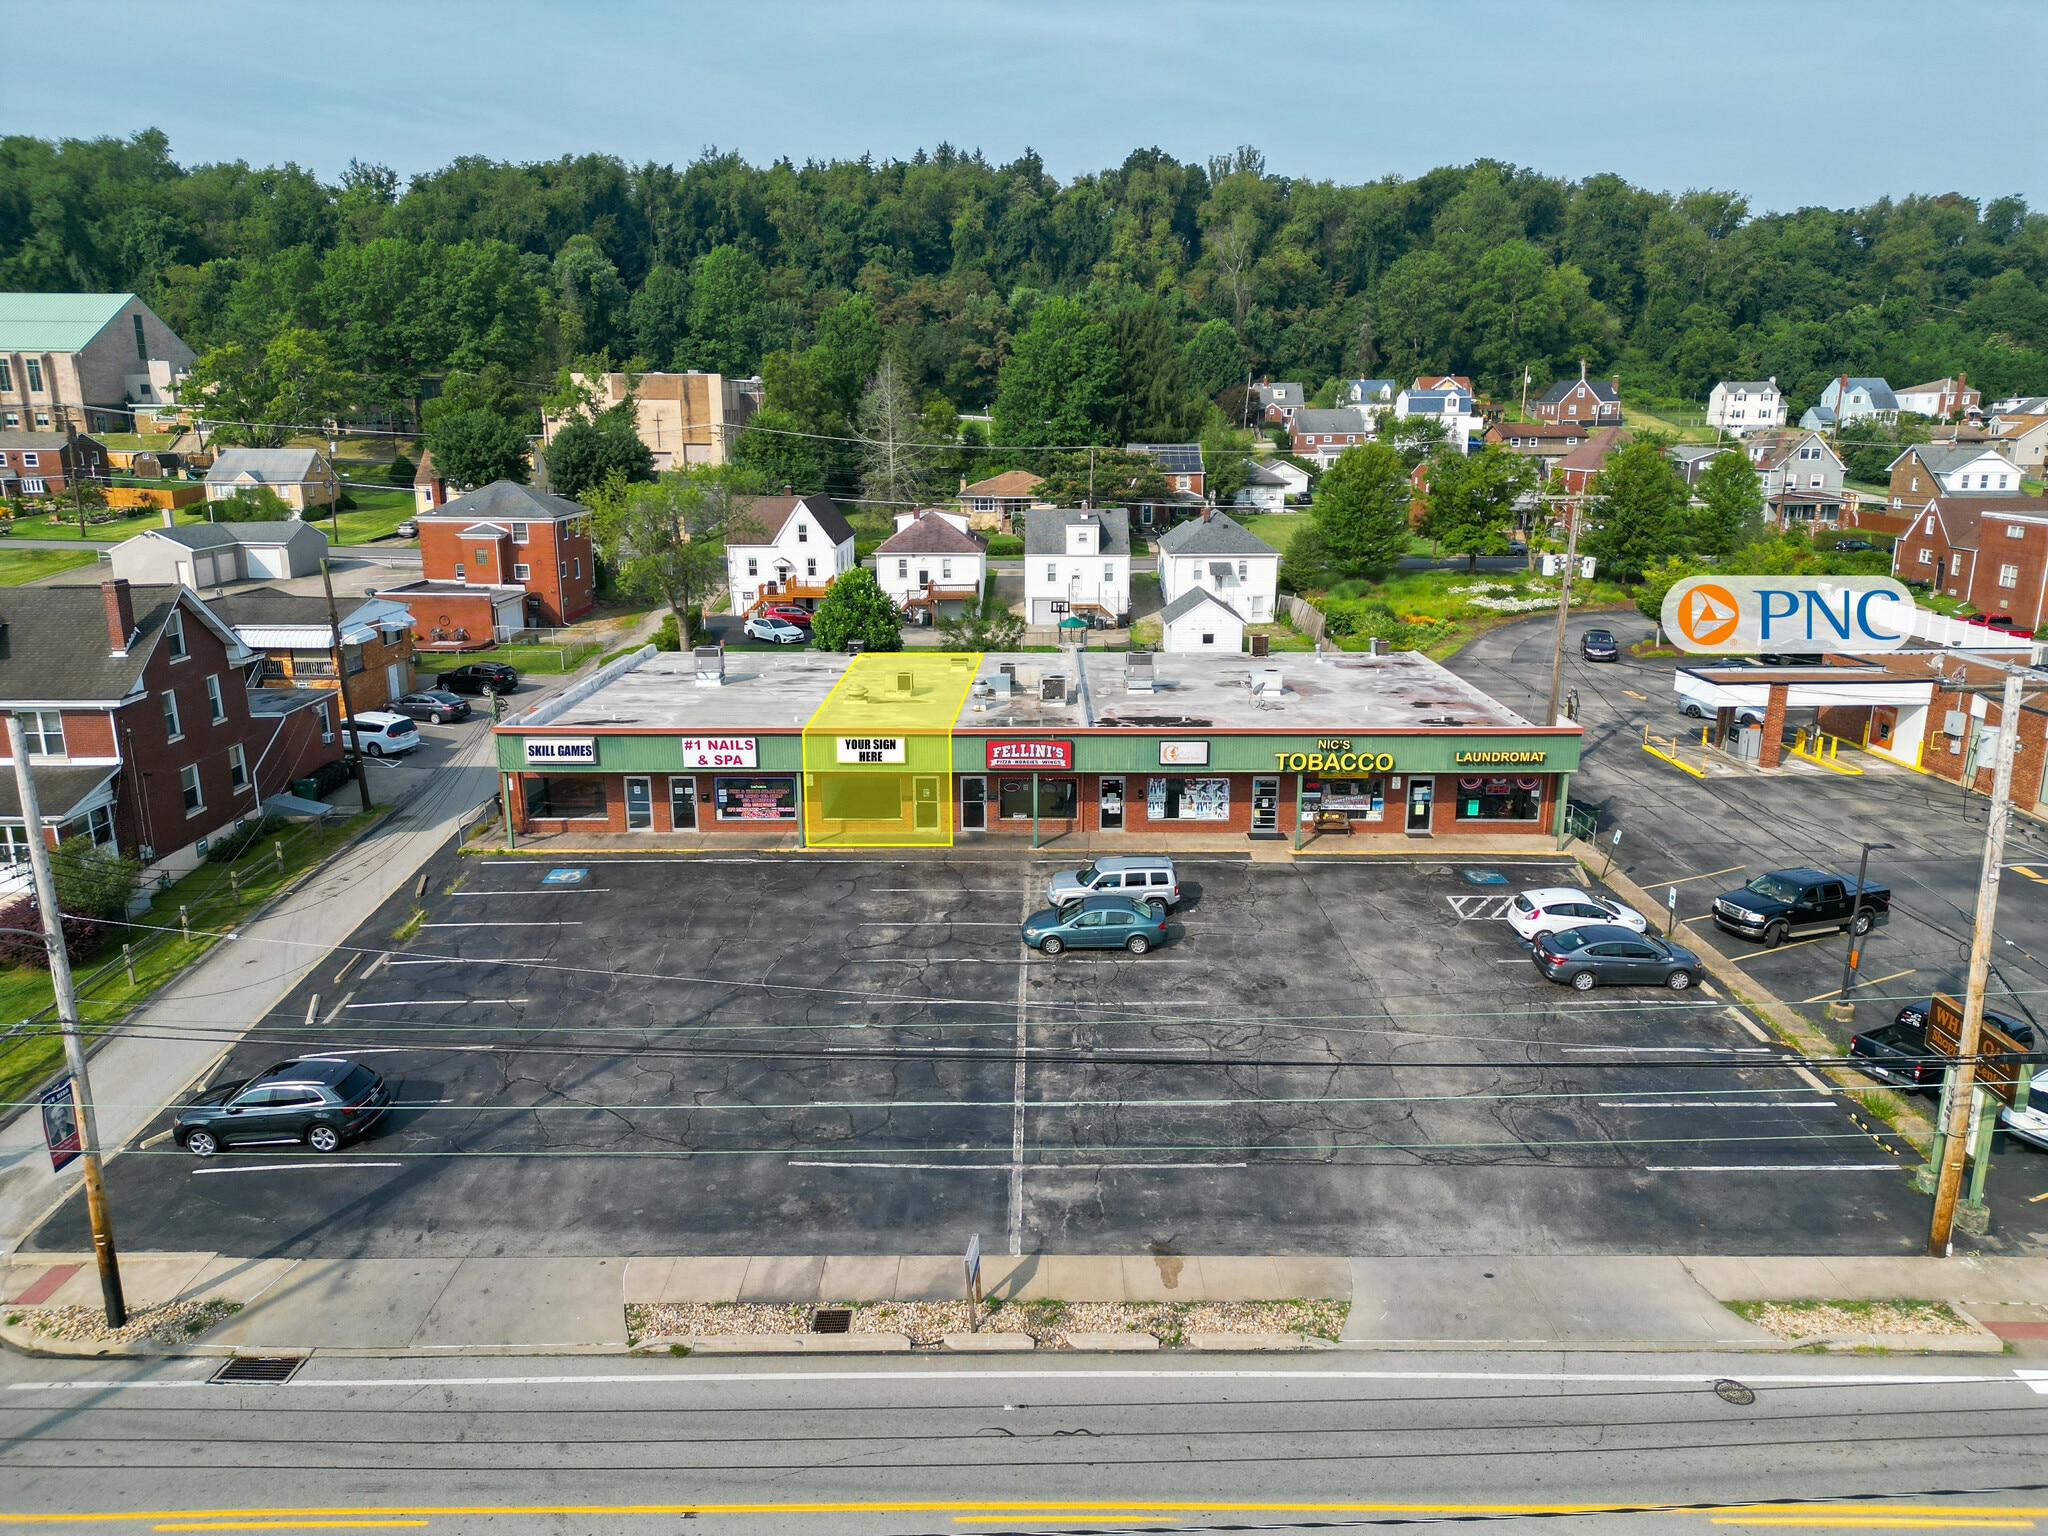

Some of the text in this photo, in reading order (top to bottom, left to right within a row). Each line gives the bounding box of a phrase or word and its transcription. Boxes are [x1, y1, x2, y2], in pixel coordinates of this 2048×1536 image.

[684, 740, 754, 751] #1 NAILS
[845, 739, 896, 750] YOUR SIGN
[1318, 739, 1351, 750] NIC'S
[528, 745, 592, 757] SKILL GAMES
[992, 743, 1064, 758] FELLINI'S
[698, 754, 743, 765] & SPA
[859, 751, 883, 762] HERE
[1274, 752, 1394, 772] TOBACCO
[1455, 751, 1546, 763] LAUNDROMAT
